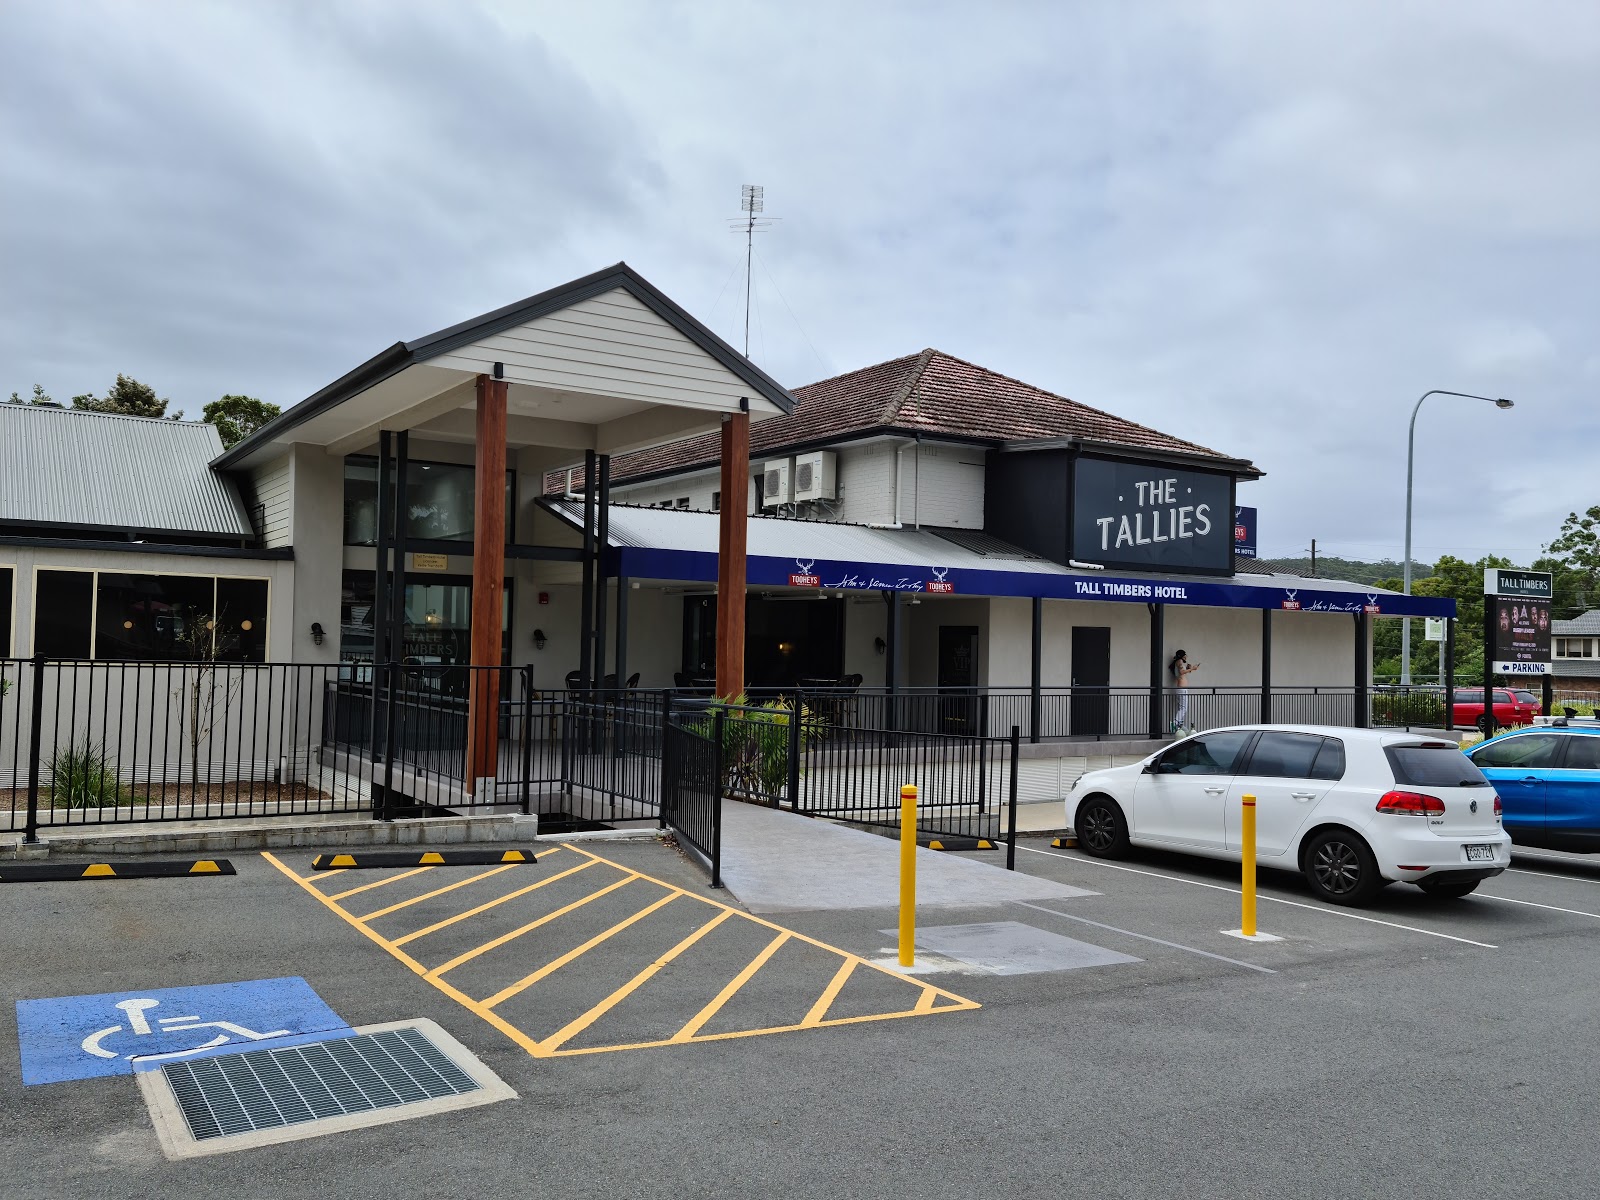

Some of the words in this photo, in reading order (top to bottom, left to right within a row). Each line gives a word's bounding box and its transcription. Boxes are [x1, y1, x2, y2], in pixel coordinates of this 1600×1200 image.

[1135, 478, 1178, 507] THE
[1096, 503, 1212, 551] TALLIES
[791, 575, 818, 584] TOOHEYS
[1500, 577, 1519, 588] TALL
[1519, 579, 1548, 590] TIMBERS
[928, 582, 952, 591] TOOHEYS
[1074, 581, 1101, 594] TALL
[1103, 583, 1152, 597] TIMBERS
[1154, 586, 1188, 599] HOTEL
[411, 632, 440, 642] TALL
[404, 643, 453, 655] IMBERS
[1512, 663, 1545, 673] PARKING
